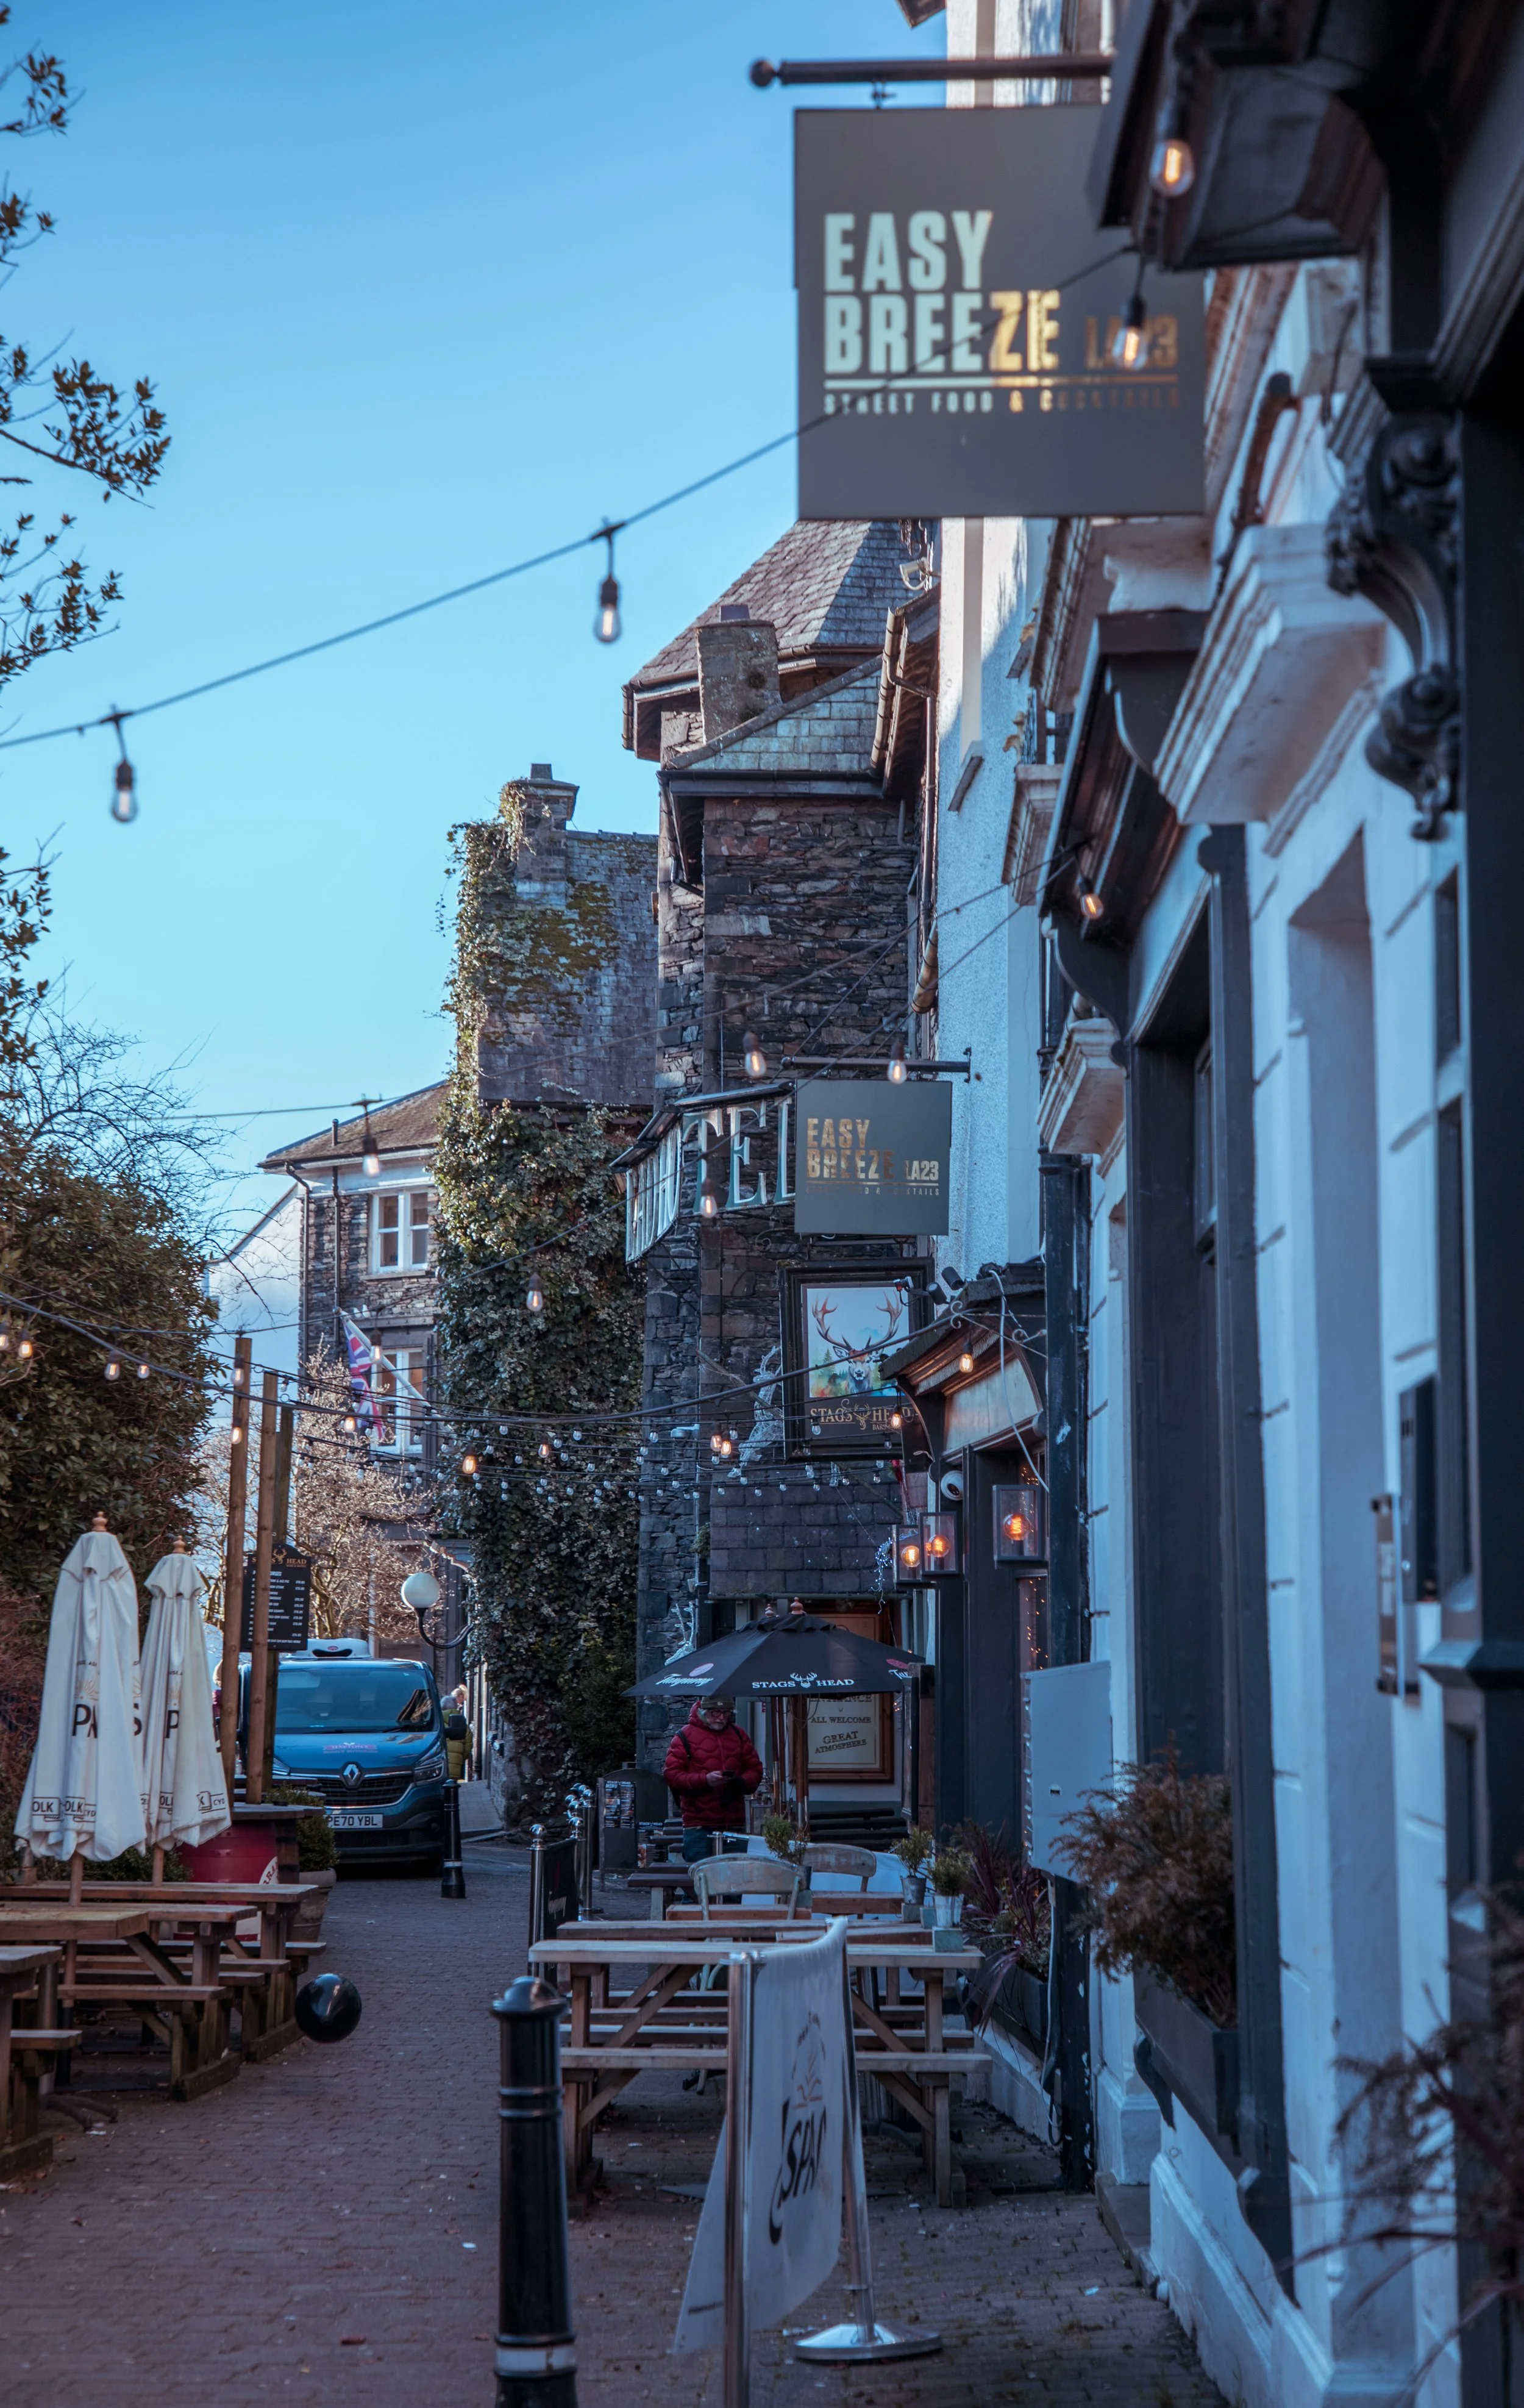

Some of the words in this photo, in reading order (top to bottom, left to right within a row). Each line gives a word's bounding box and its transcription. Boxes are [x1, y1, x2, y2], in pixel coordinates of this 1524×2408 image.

[825, 211, 992, 291] EASY
[825, 290, 1059, 373] BREEZE
[824, 391, 914, 414] STREET
[931, 390, 993, 413] FOOD
[1009, 388, 1025, 412] &
[807, 1118, 870, 1148] EASY
[807, 1148, 894, 1179] BREEZE
[905, 1160, 939, 1180] LA23
[810, 1408, 853, 1423] STAGS
[872, 1407, 911, 1421] HED
[815, 1739, 867, 1754] ATMOSPHERE
[823, 1731, 858, 1745] GREAT
[328, 1816, 354, 1826] PE70
[357, 1816, 377, 1826] YBL
